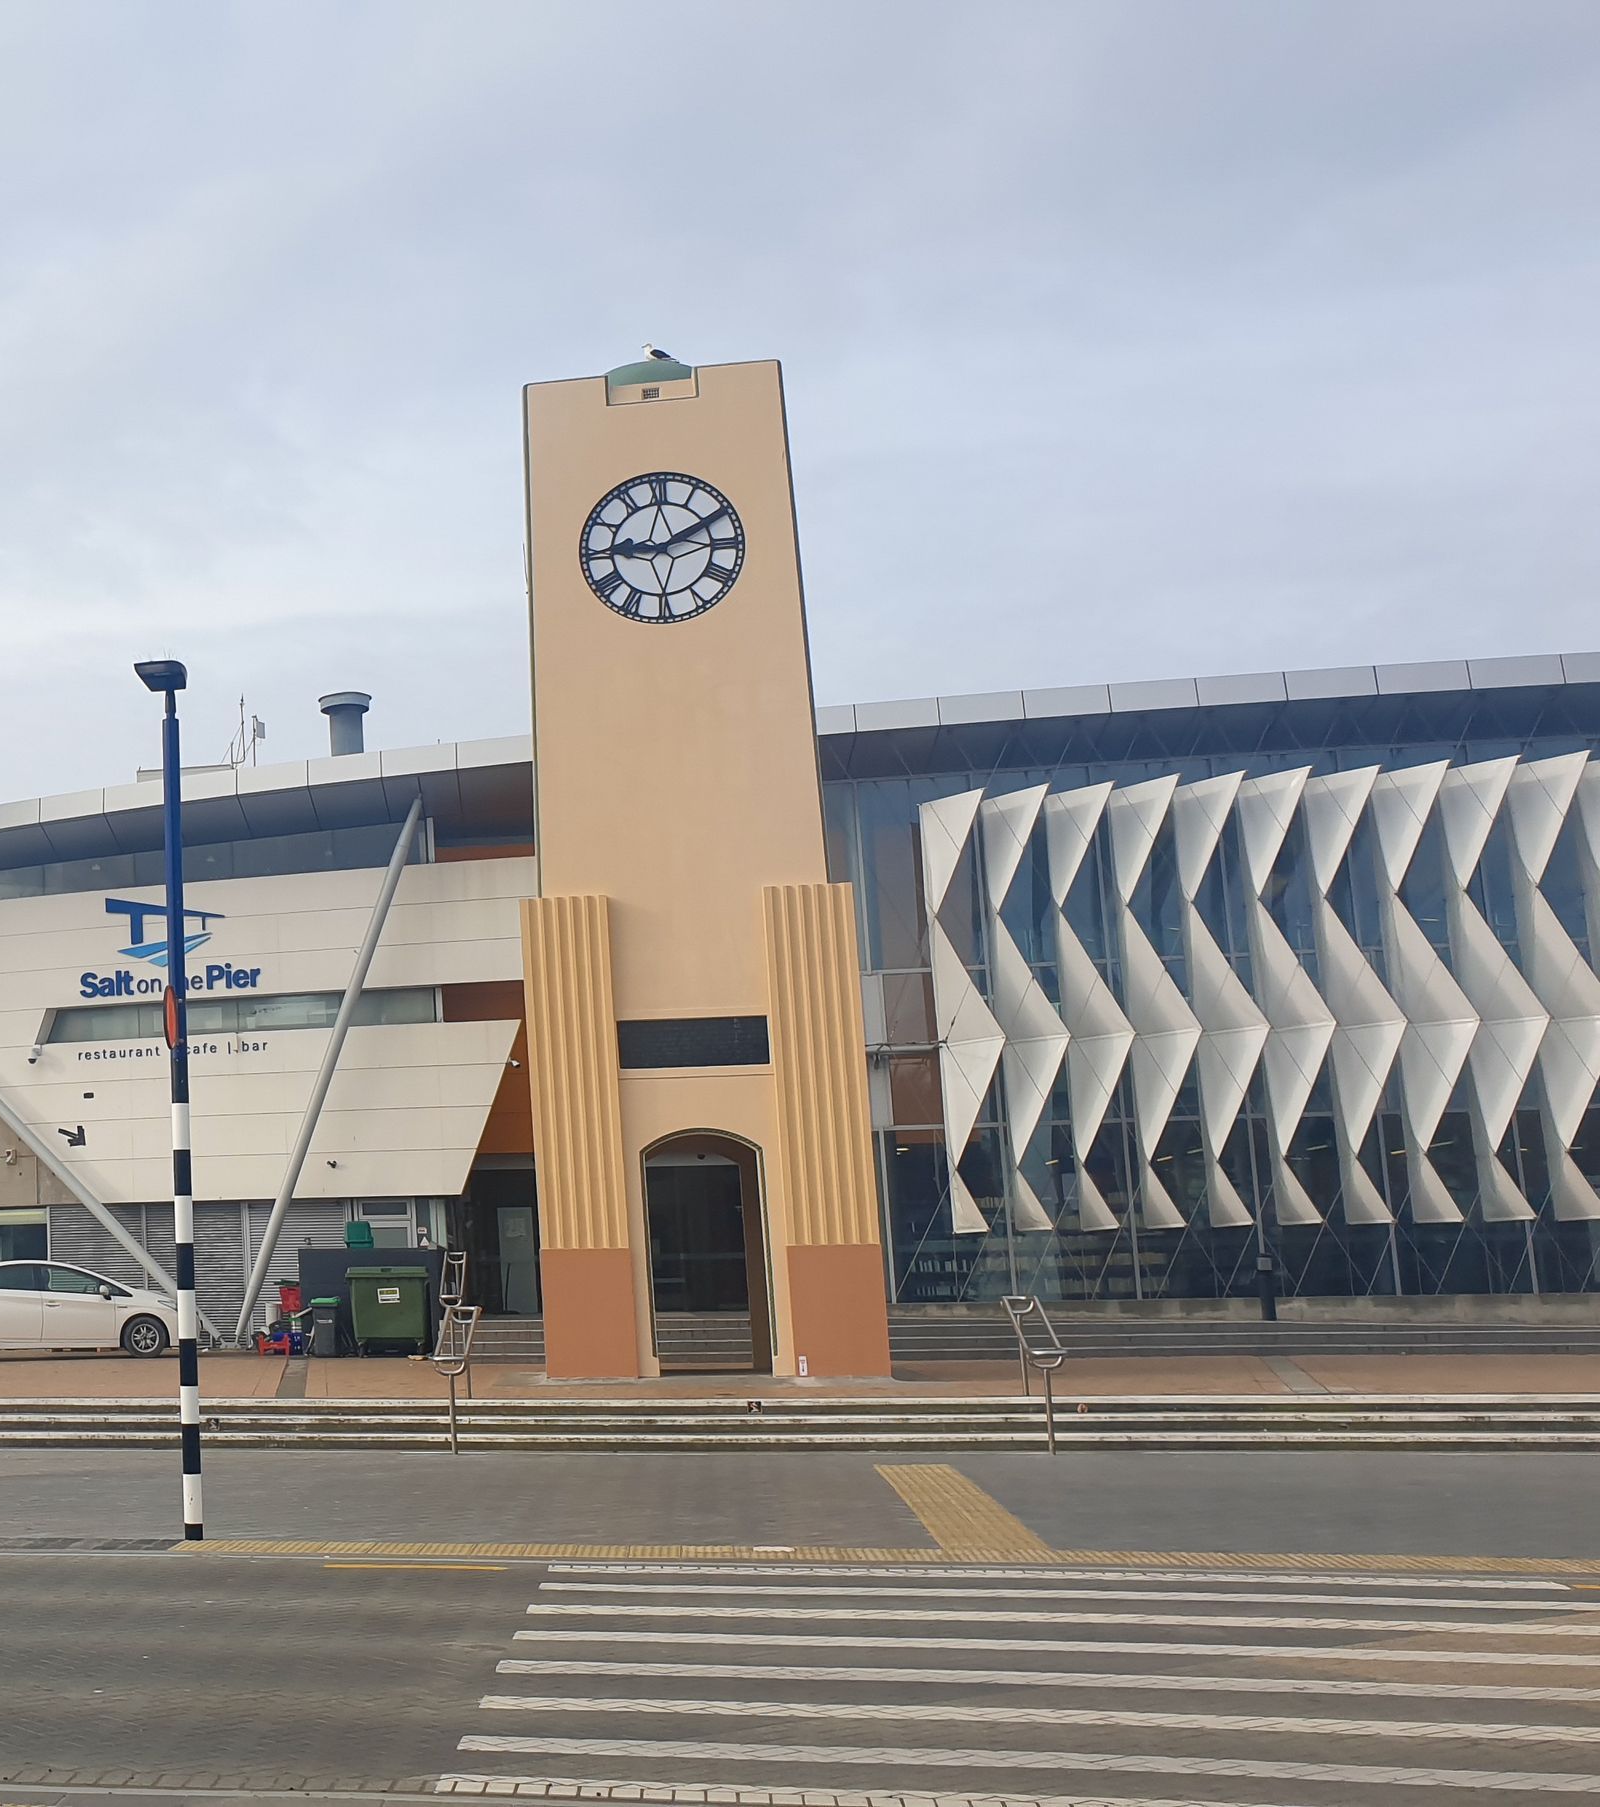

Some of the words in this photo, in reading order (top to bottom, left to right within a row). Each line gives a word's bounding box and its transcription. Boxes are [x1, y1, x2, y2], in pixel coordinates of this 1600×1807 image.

[80, 970, 135, 998] Salt
[137, 978, 162, 994] on
[206, 963, 261, 990] Pier
[78, 1046, 161, 1061] restaurant
[242, 1040, 268, 1052] bar
